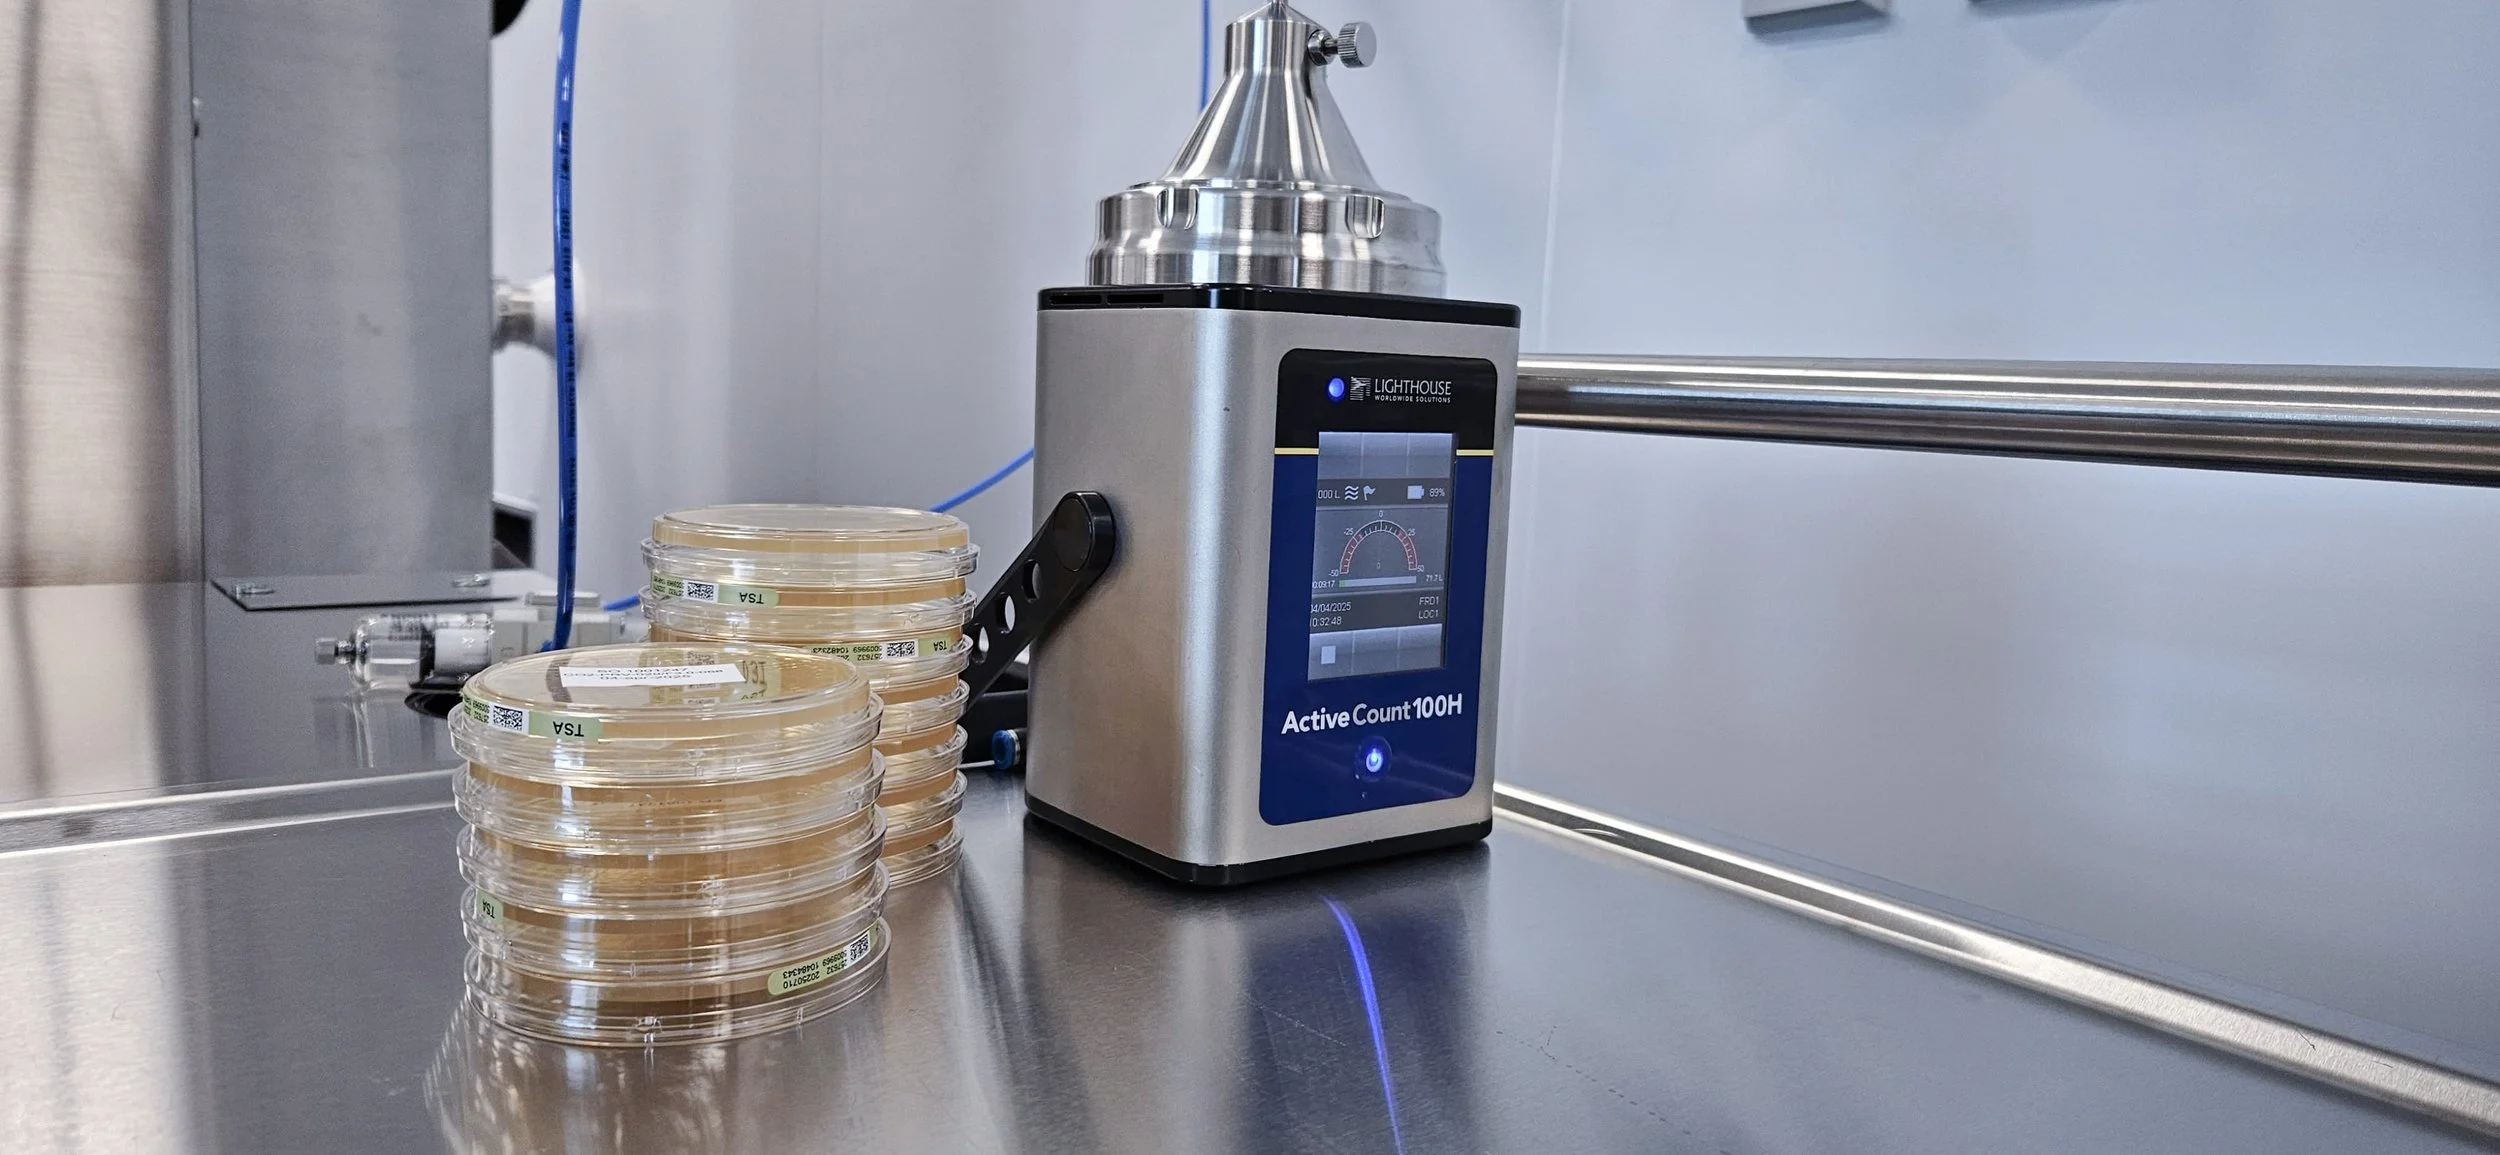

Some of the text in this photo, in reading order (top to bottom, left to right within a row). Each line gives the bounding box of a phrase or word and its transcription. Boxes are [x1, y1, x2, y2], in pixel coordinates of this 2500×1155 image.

[1374, 378, 1452, 395] LIGHTHOUSE
[1374, 394, 1451, 403] WORLDWIDE SOLUTIONS
[1429, 487, 1445, 497] 89%
[1378, 510, 1384, 518] 0
[738, 592, 764, 604] TSA
[933, 641, 947, 651] TSA
[1281, 693, 1463, 735] Active Count 100H
[553, 721, 585, 738] TSA
[482, 899, 496, 919] TSA
[783, 961, 819, 979] 10484343
[783, 970, 820, 989] 20250710
